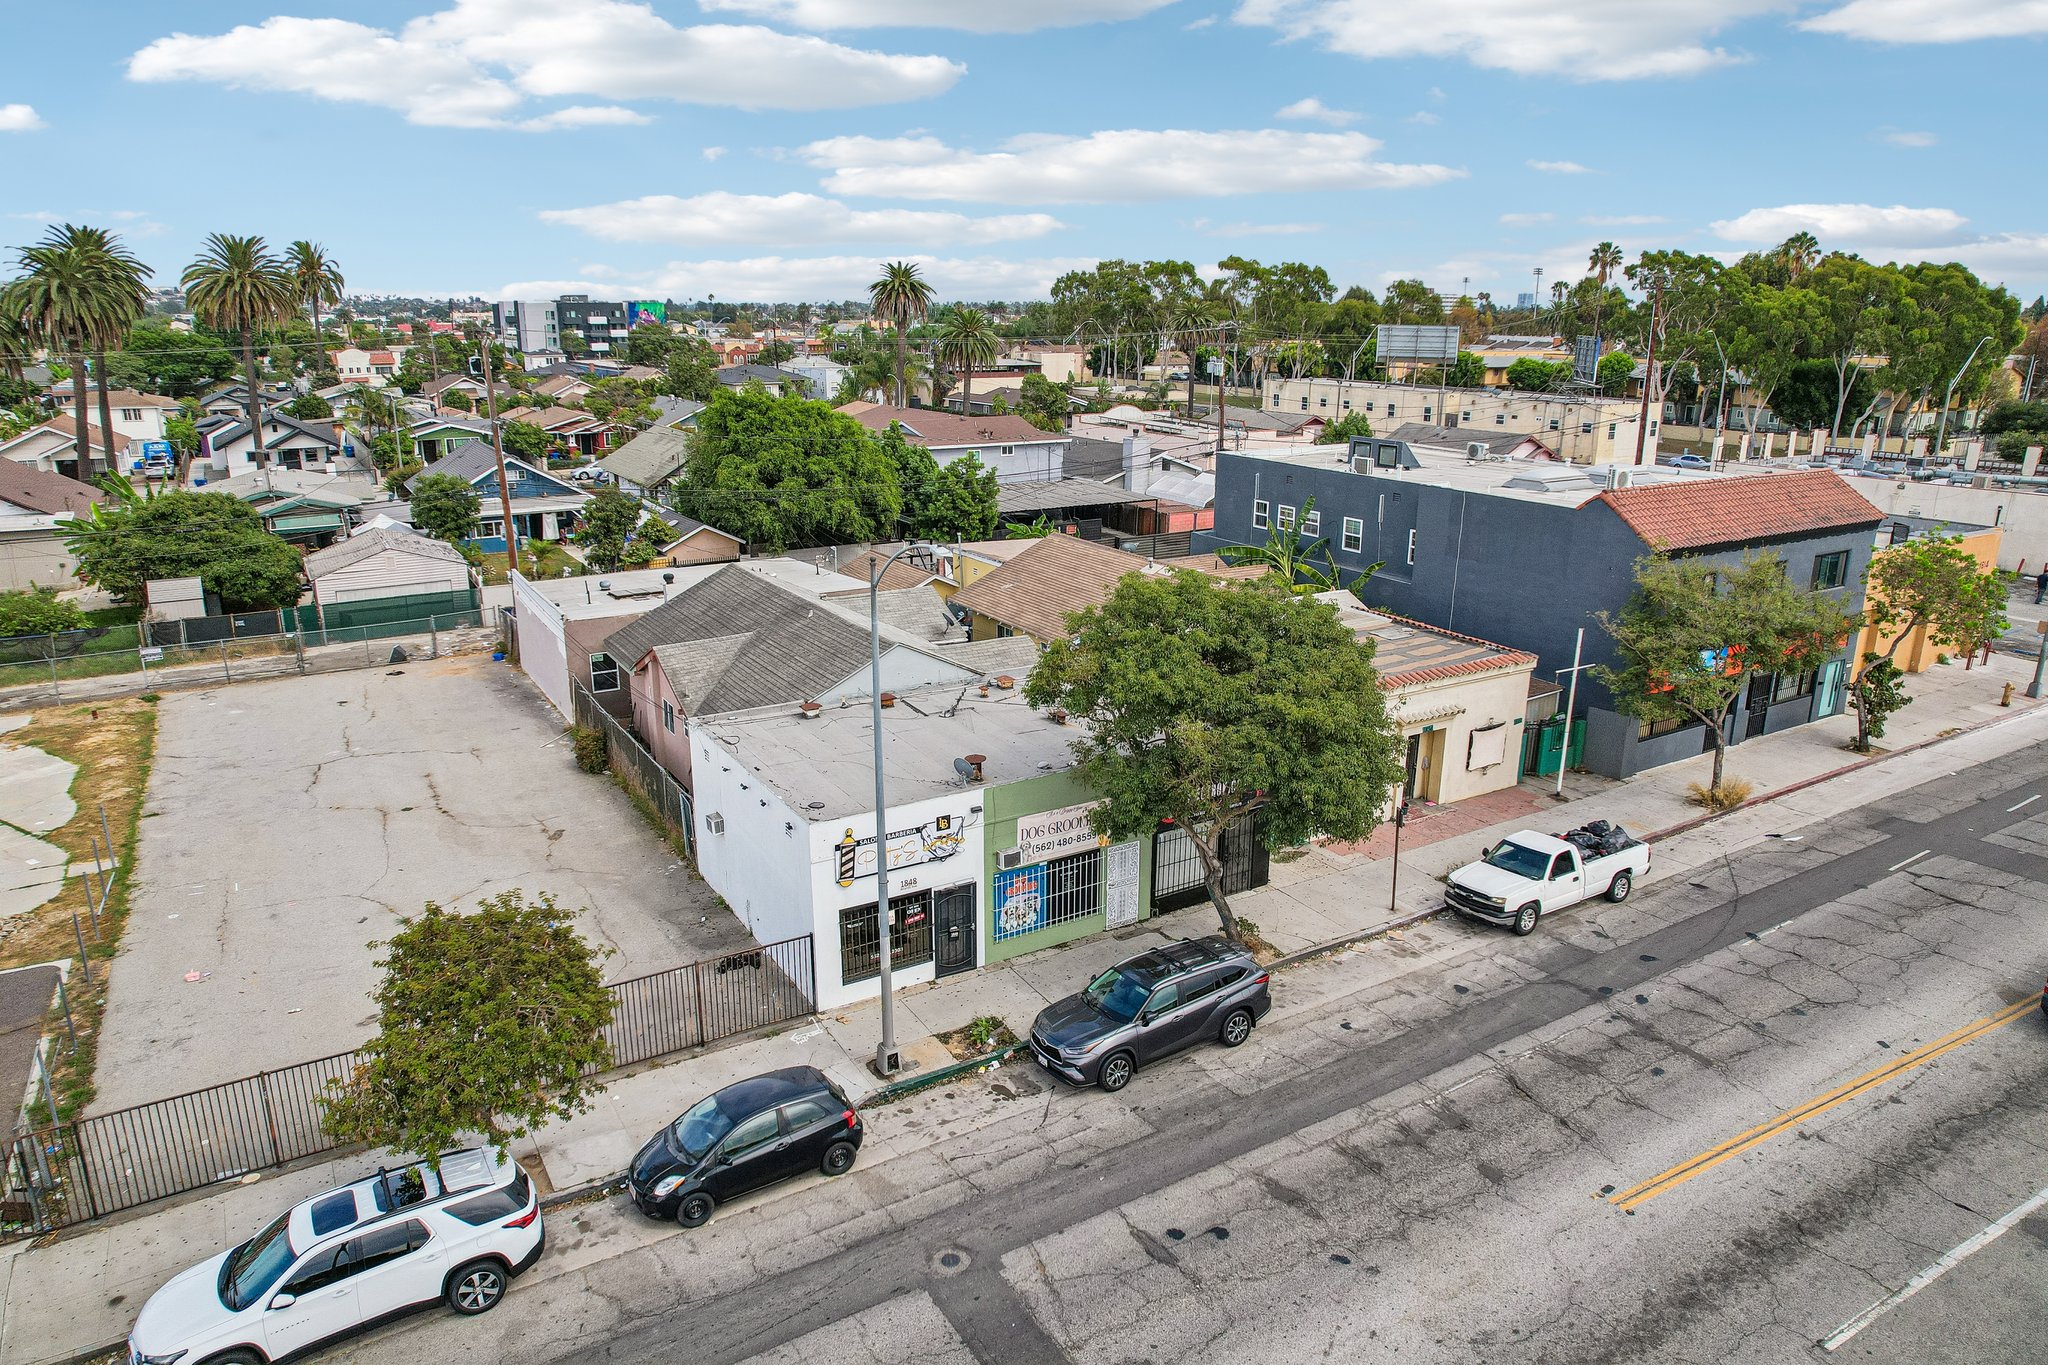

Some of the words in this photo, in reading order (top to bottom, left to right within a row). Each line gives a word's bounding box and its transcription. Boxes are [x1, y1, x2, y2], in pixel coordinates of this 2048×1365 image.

[1020, 825, 1045, 841] DOG
[1047, 815, 1092, 835] GROOM
[859, 837, 878, 846] SALO
[886, 828, 917, 840] BARBERIA
[1032, 841, 1055, 855] (562)
[900, 877, 918, 888] 1848
